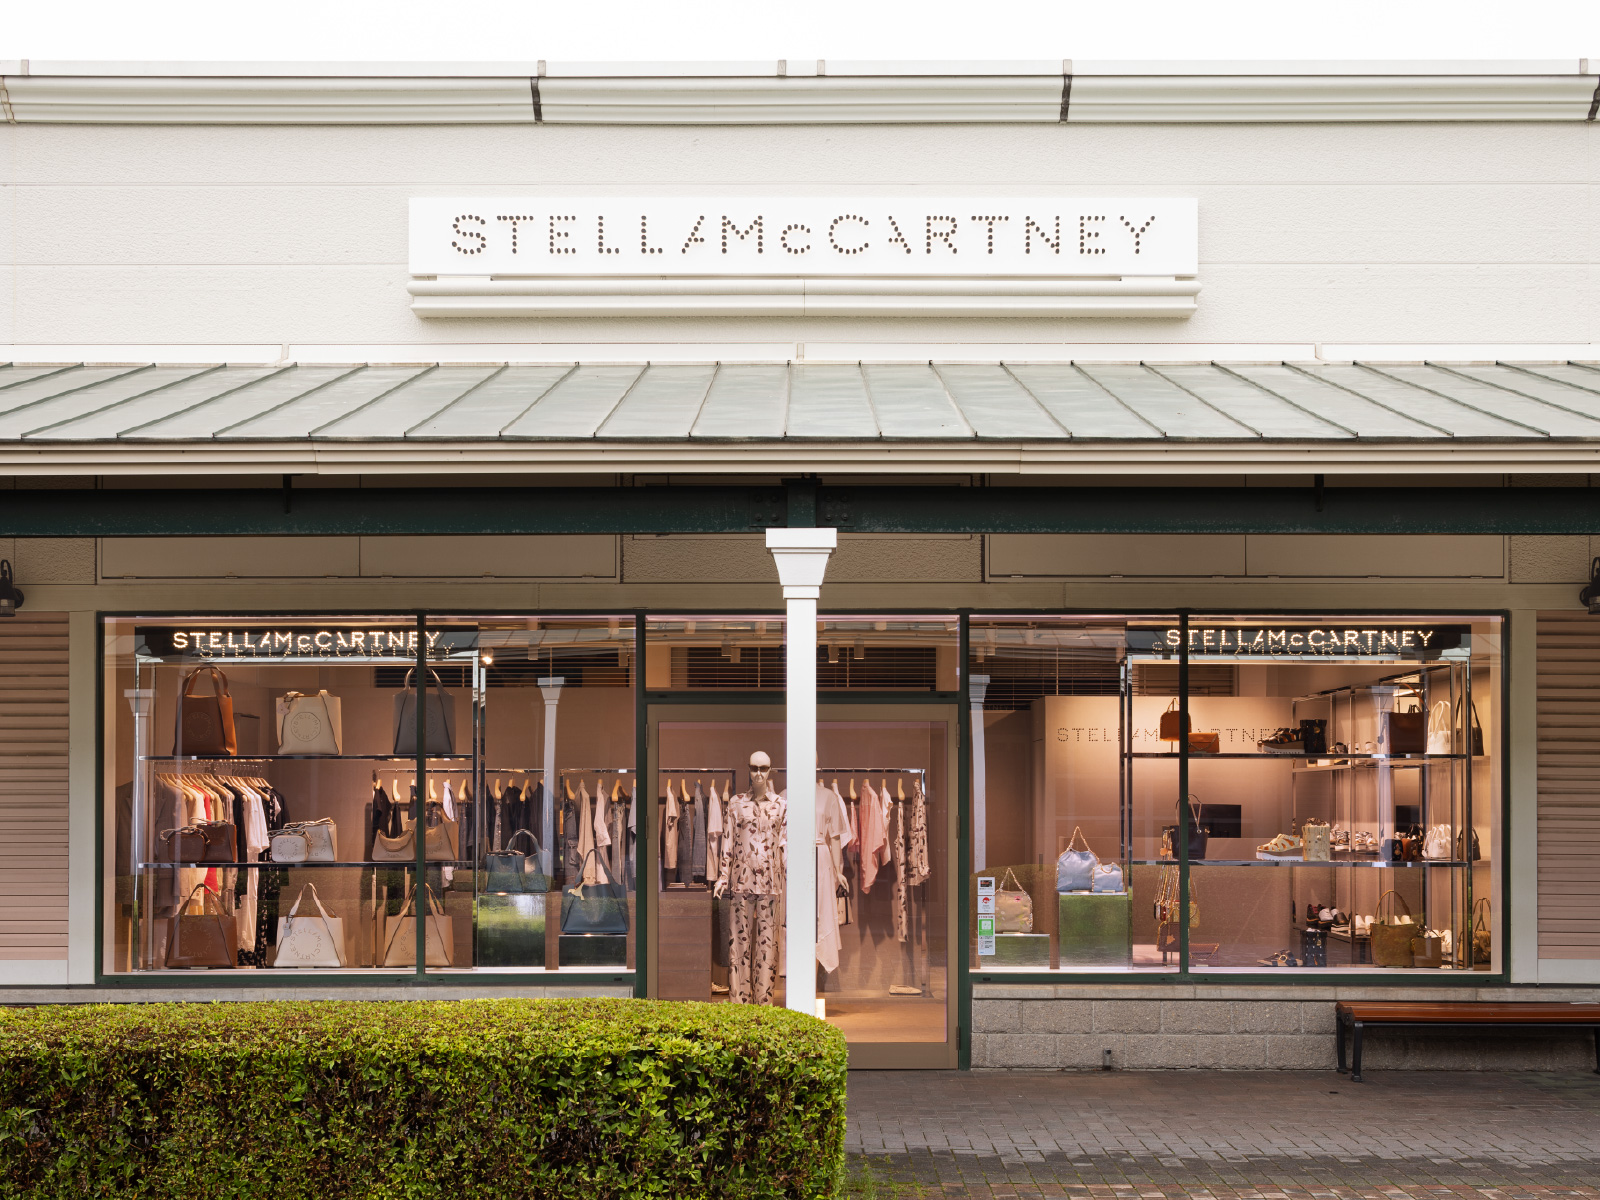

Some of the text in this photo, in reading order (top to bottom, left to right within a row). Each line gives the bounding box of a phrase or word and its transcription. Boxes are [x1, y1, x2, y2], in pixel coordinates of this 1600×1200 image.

[451, 214, 1156, 255] STELLAMcCARTNEY
[173, 631, 441, 649] STELLAMcCARTNEY
[1166, 629, 1434, 647] STELLAMcCARTNEY
